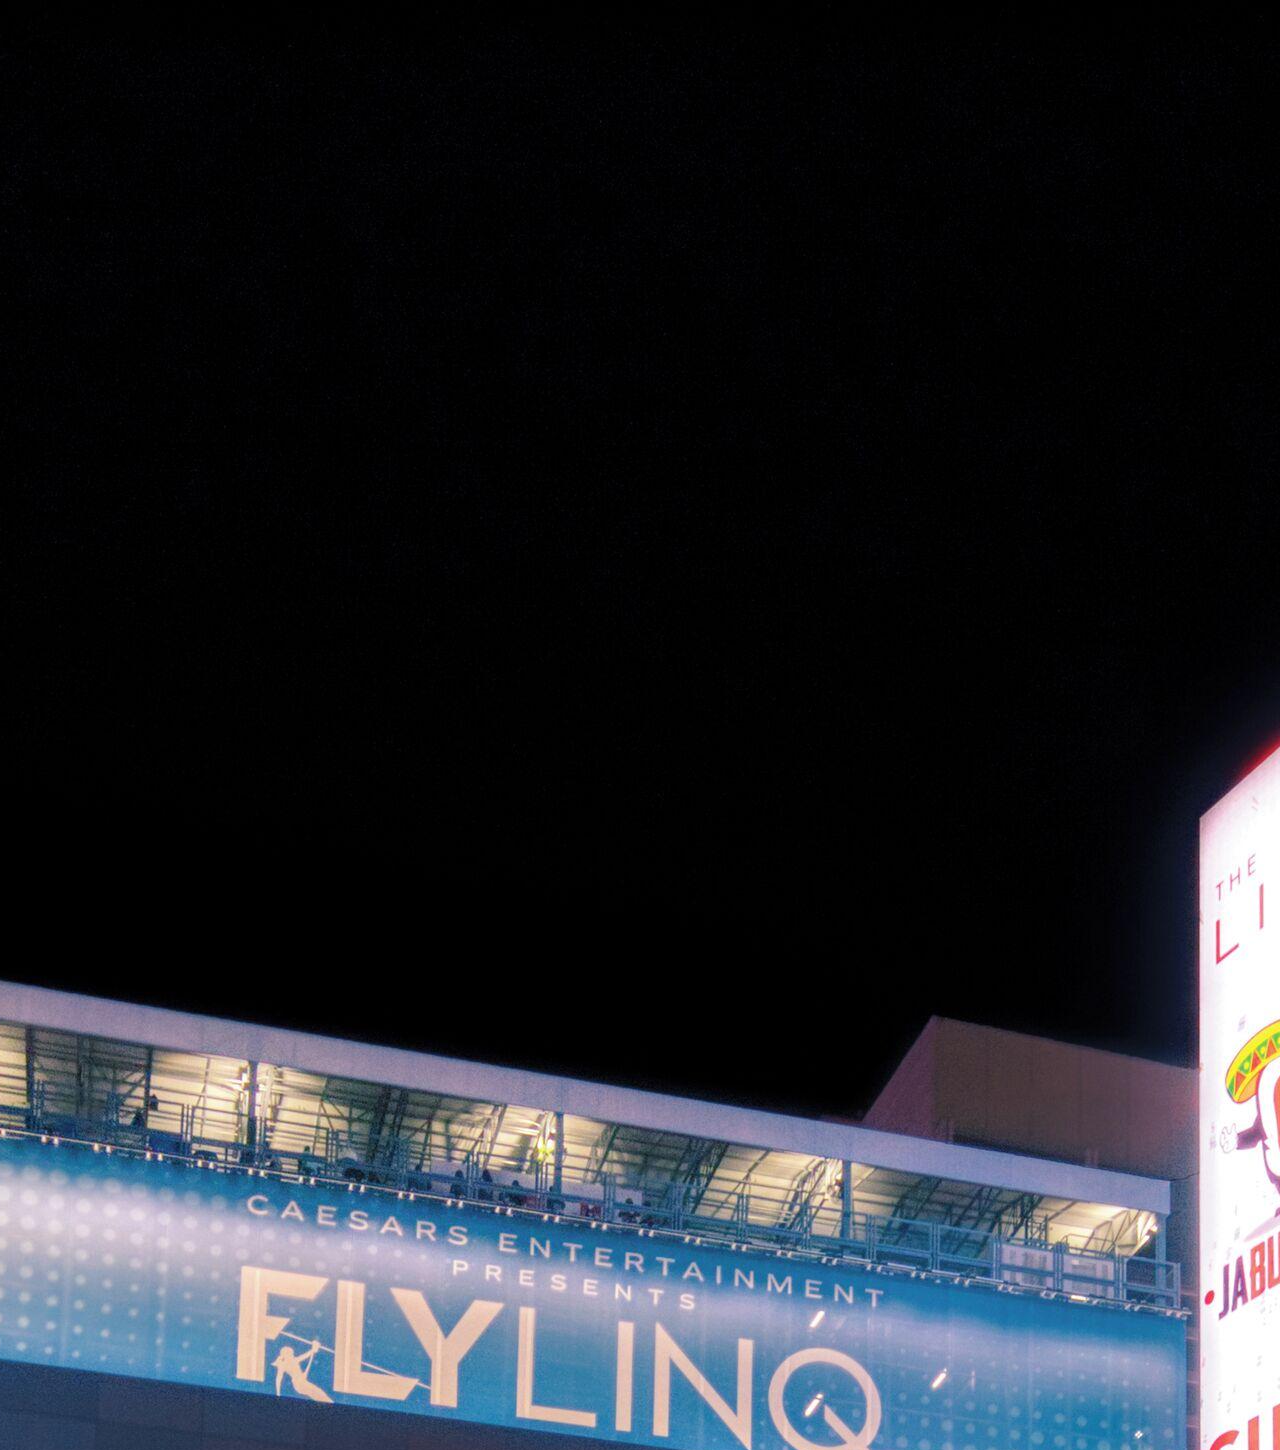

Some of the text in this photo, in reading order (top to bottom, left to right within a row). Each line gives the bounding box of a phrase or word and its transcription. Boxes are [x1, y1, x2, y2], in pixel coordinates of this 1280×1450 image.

[1215, 853, 1258, 901] THE
[246, 1194, 884, 1308] CAESARS ENTERTAINMENT
[452, 1259, 695, 1311] PRESENTS
